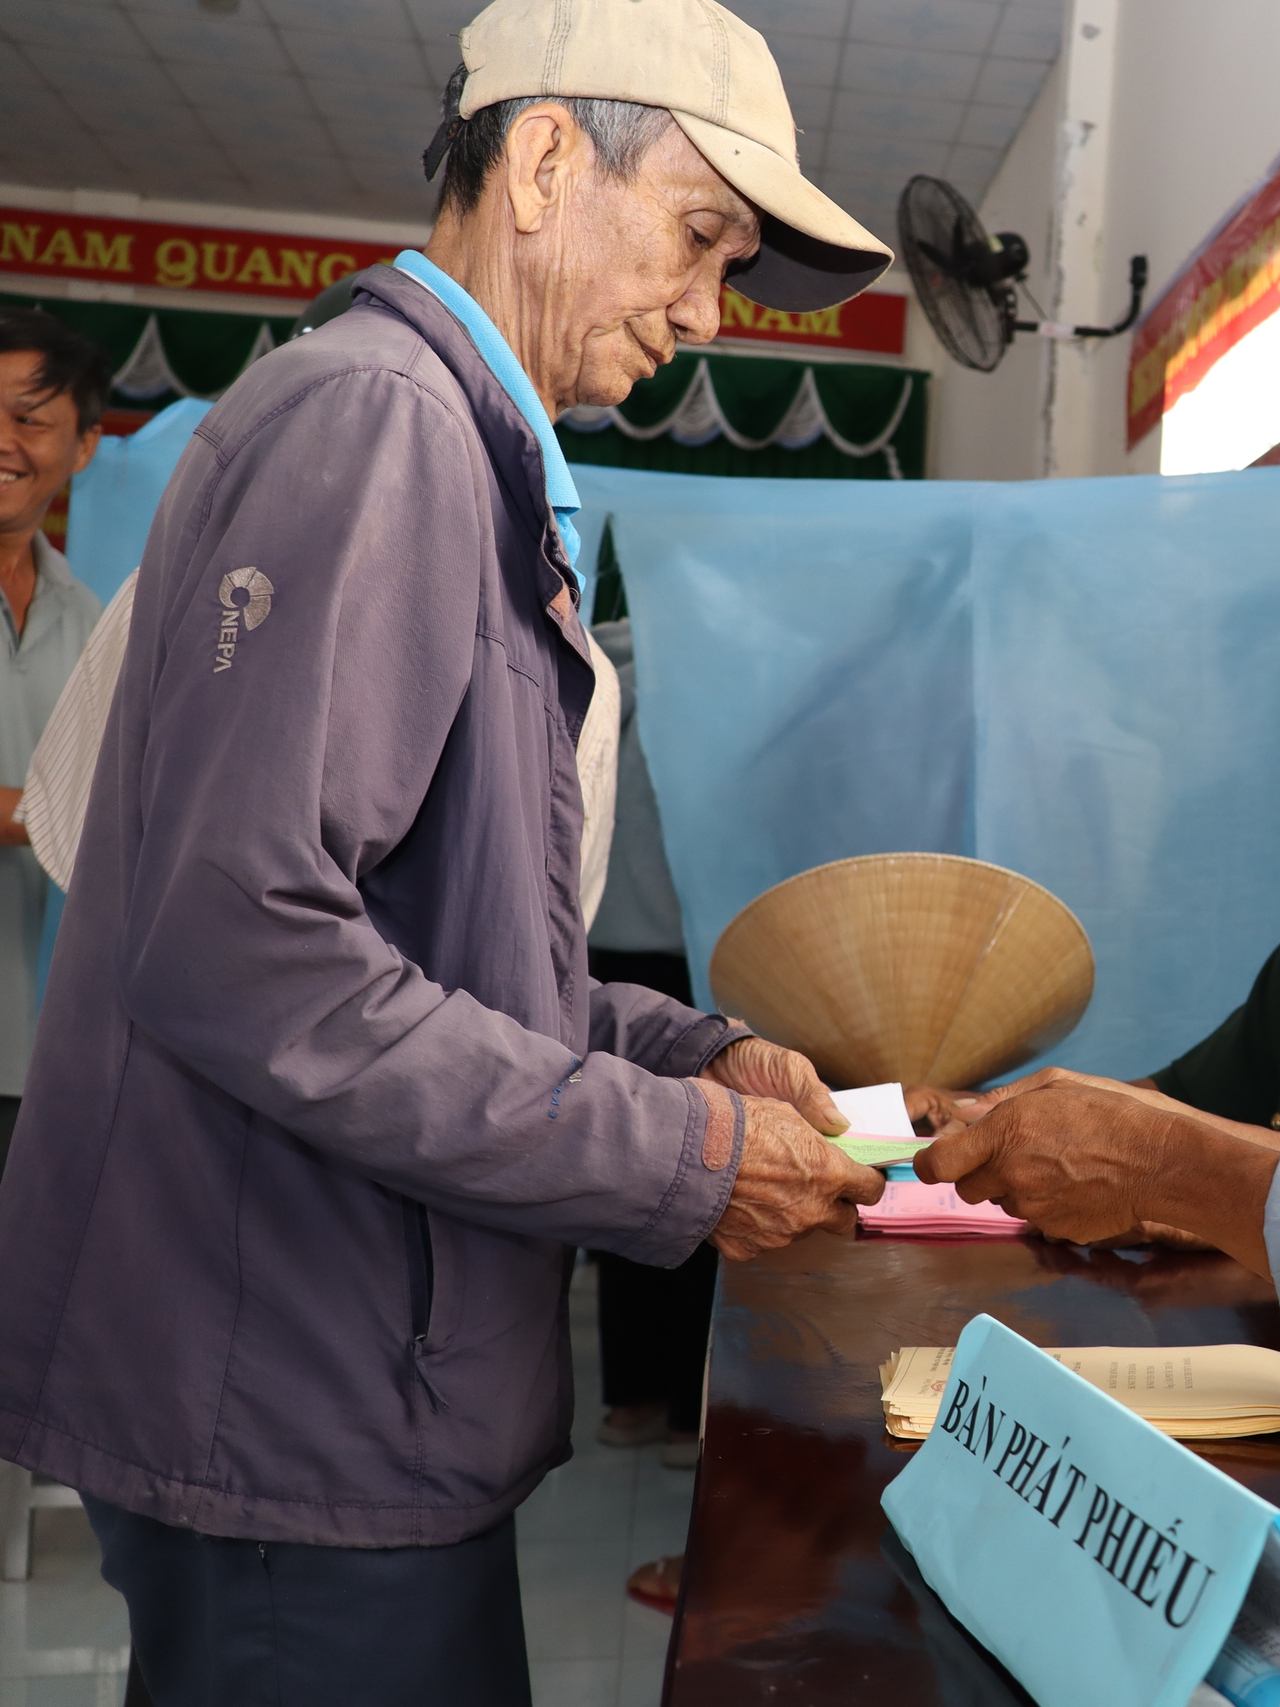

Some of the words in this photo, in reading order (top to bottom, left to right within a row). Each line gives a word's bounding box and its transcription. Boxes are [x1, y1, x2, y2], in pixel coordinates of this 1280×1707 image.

[0, 221, 135, 273] NAM
[721, 289, 845, 337] NAM
[992, 1420, 1088, 1529] PHÁT
[1073, 1484, 1218, 1630] PHIẾU
